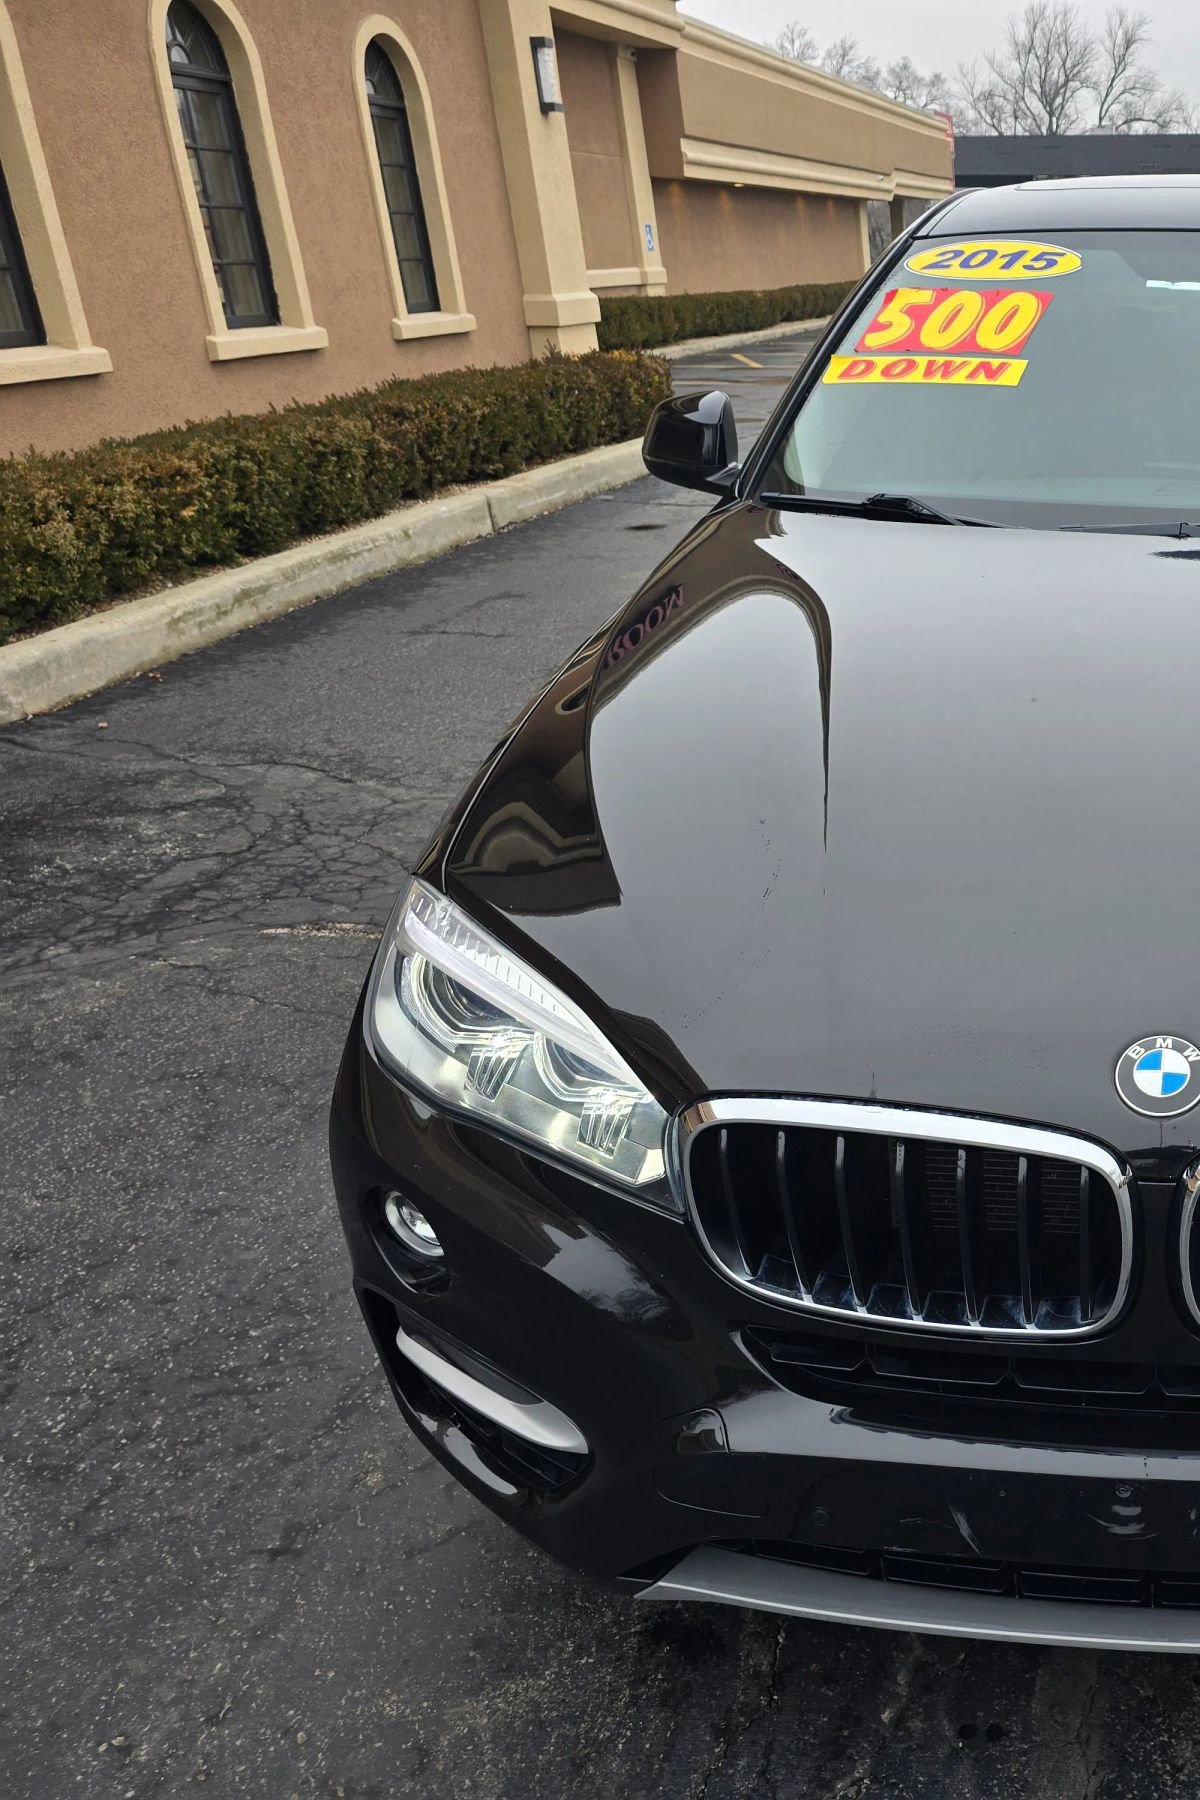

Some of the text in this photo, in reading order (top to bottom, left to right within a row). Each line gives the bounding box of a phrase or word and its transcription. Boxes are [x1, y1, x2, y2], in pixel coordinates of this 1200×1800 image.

[921, 249, 1066, 271] 2015
[863, 287, 1043, 351] 500
[837, 359, 1013, 381] DOWN
